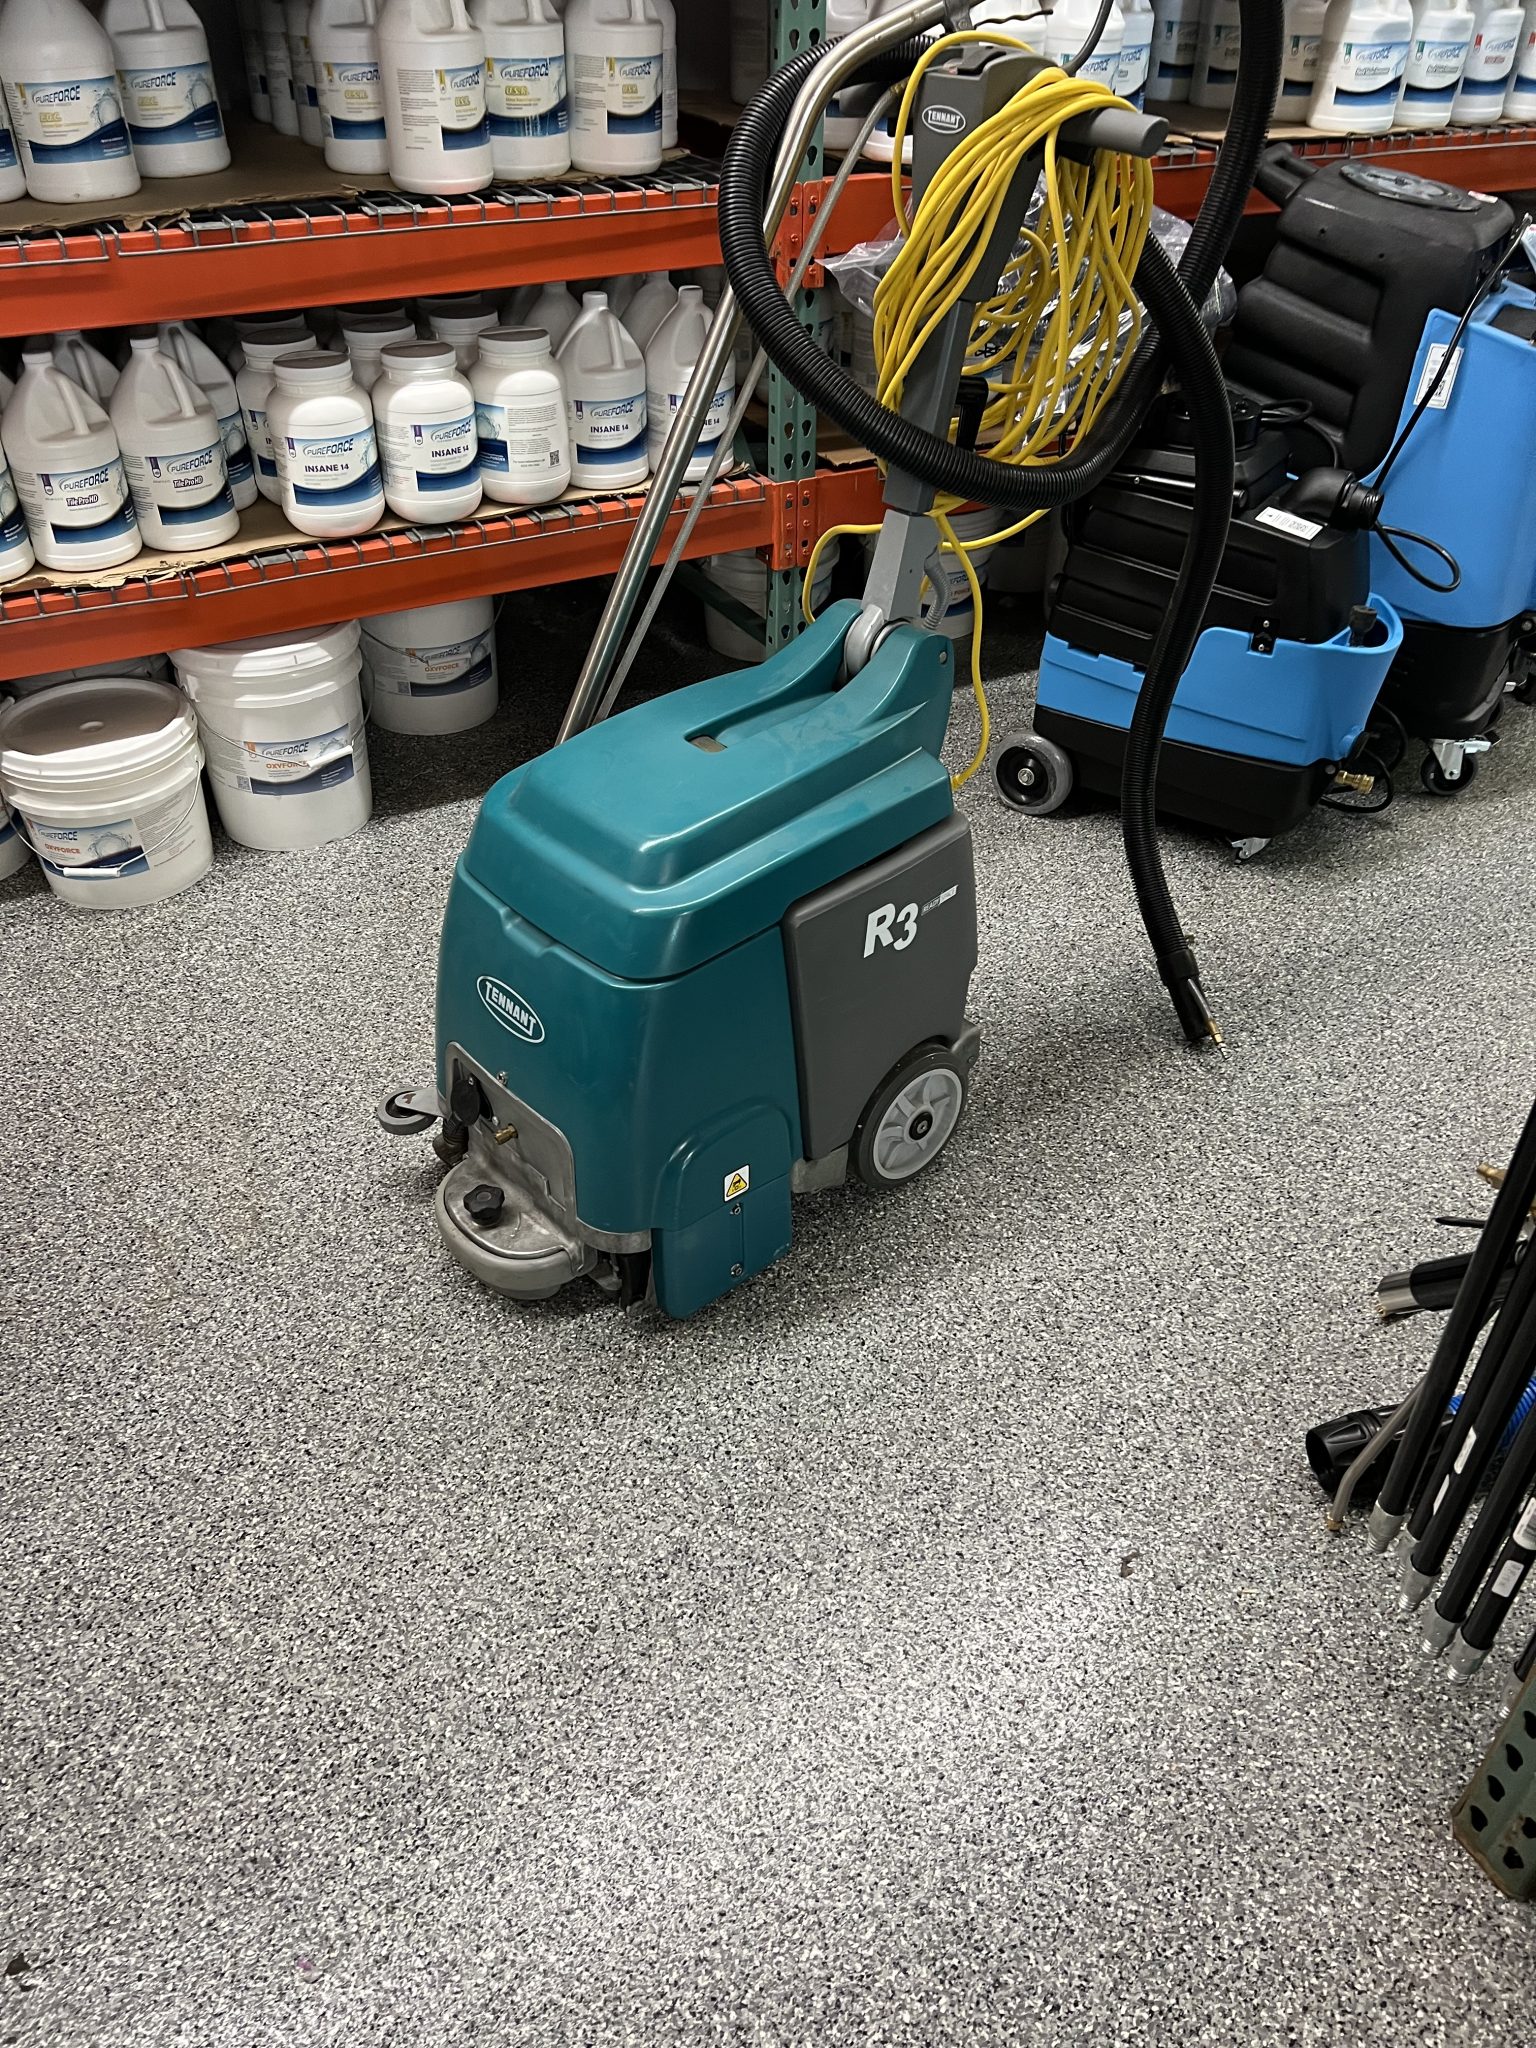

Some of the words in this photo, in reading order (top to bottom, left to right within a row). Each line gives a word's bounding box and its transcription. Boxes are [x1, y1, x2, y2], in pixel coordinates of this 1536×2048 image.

[504, 61, 551, 78] PUREFORCE
[622, 61, 652, 76] PUREFORCE
[134, 71, 177, 89] PUREFORCE
[453, 70, 480, 89] PUREFORCE
[35, 84, 81, 104] PUREFORCE
[928, 110, 961, 129] TENNANT
[593, 400, 634, 417] PUREFORCE
[433, 419, 472, 441] PUREFORCE
[590, 425, 622, 433] INSANE
[306, 437, 354, 456] PUREFORCE
[431, 447, 462, 458] INSANE
[171, 449, 213, 472] PUREFORCE
[304, 465, 339, 473] INSANE
[340, 463, 349, 471] 14
[64, 467, 110, 491] PUREFORCE
[424, 663, 459, 673] OXYFORCE
[265, 741, 310, 756] PUREFORCE
[40, 830, 78, 842] PUREFORCE
[44, 843, 81, 855] OXYFORCE
[863, 902, 919, 959] R3
[485, 980, 537, 1037] TENNANT
